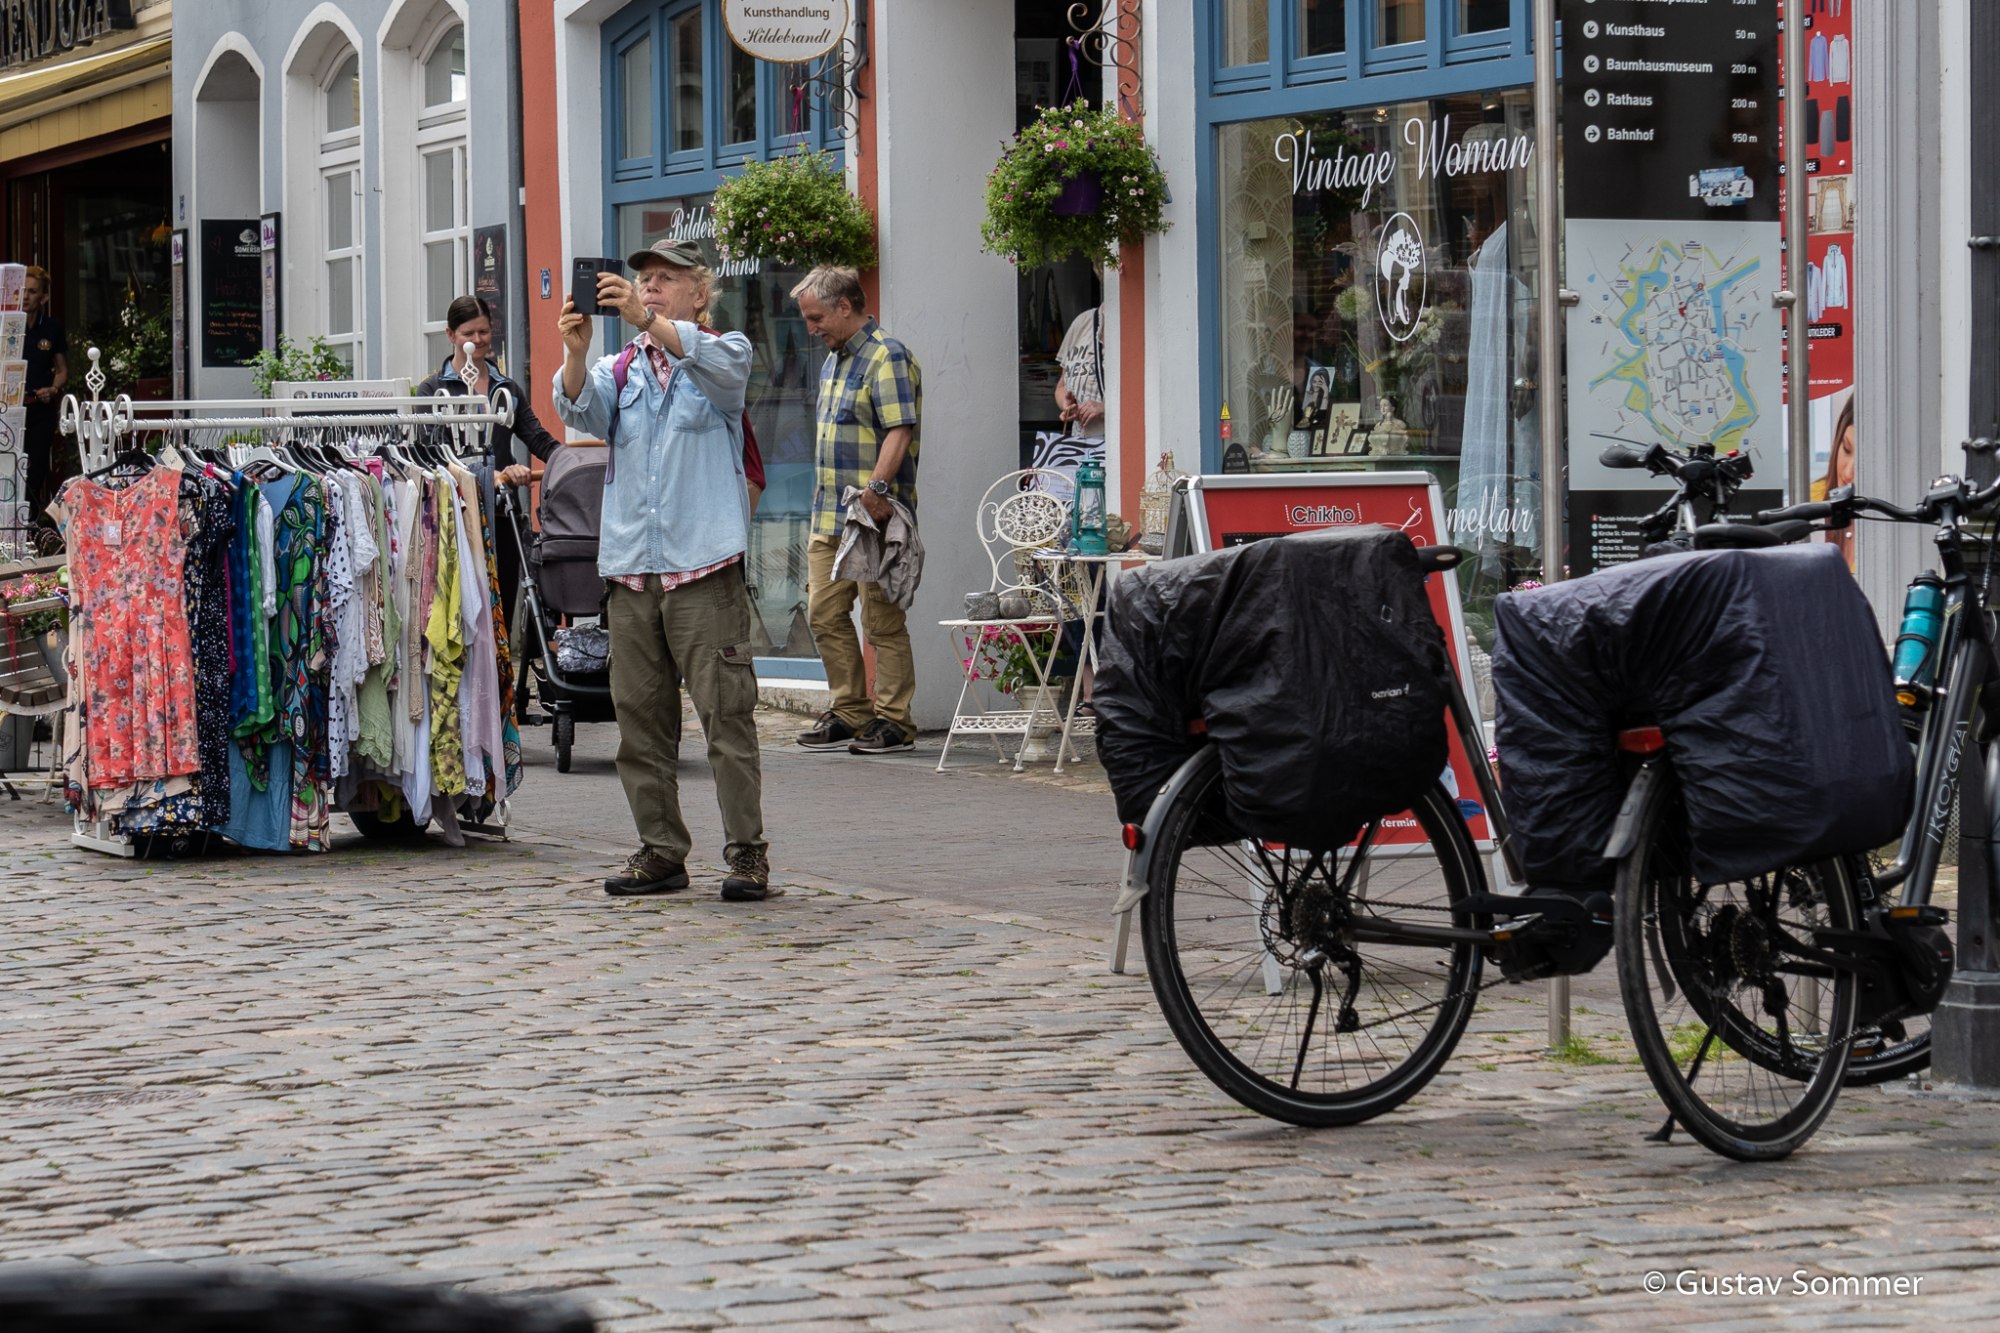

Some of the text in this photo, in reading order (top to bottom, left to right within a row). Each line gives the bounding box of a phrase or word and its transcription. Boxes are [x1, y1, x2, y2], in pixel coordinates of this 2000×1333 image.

[743, 7, 830, 20] Kunsthandlung
[1606, 23, 1665, 37] Kunsthaus
[1735, 30, 1746, 39] 50
[1606, 58, 1757, 74] Baumhausmuseum 200 m
[1607, 93, 1757, 108] Rathaus 200 m
[1607, 128, 1758, 143] Bahnhof 950 m
[1274, 113, 1535, 210] Vintage Woman
[234, 245, 261, 254] SOMERSB
[311, 391, 358, 399] ERDINGER
[1292, 506, 1355, 524] Chikho
[1446, 485, 1534, 551] meflair
